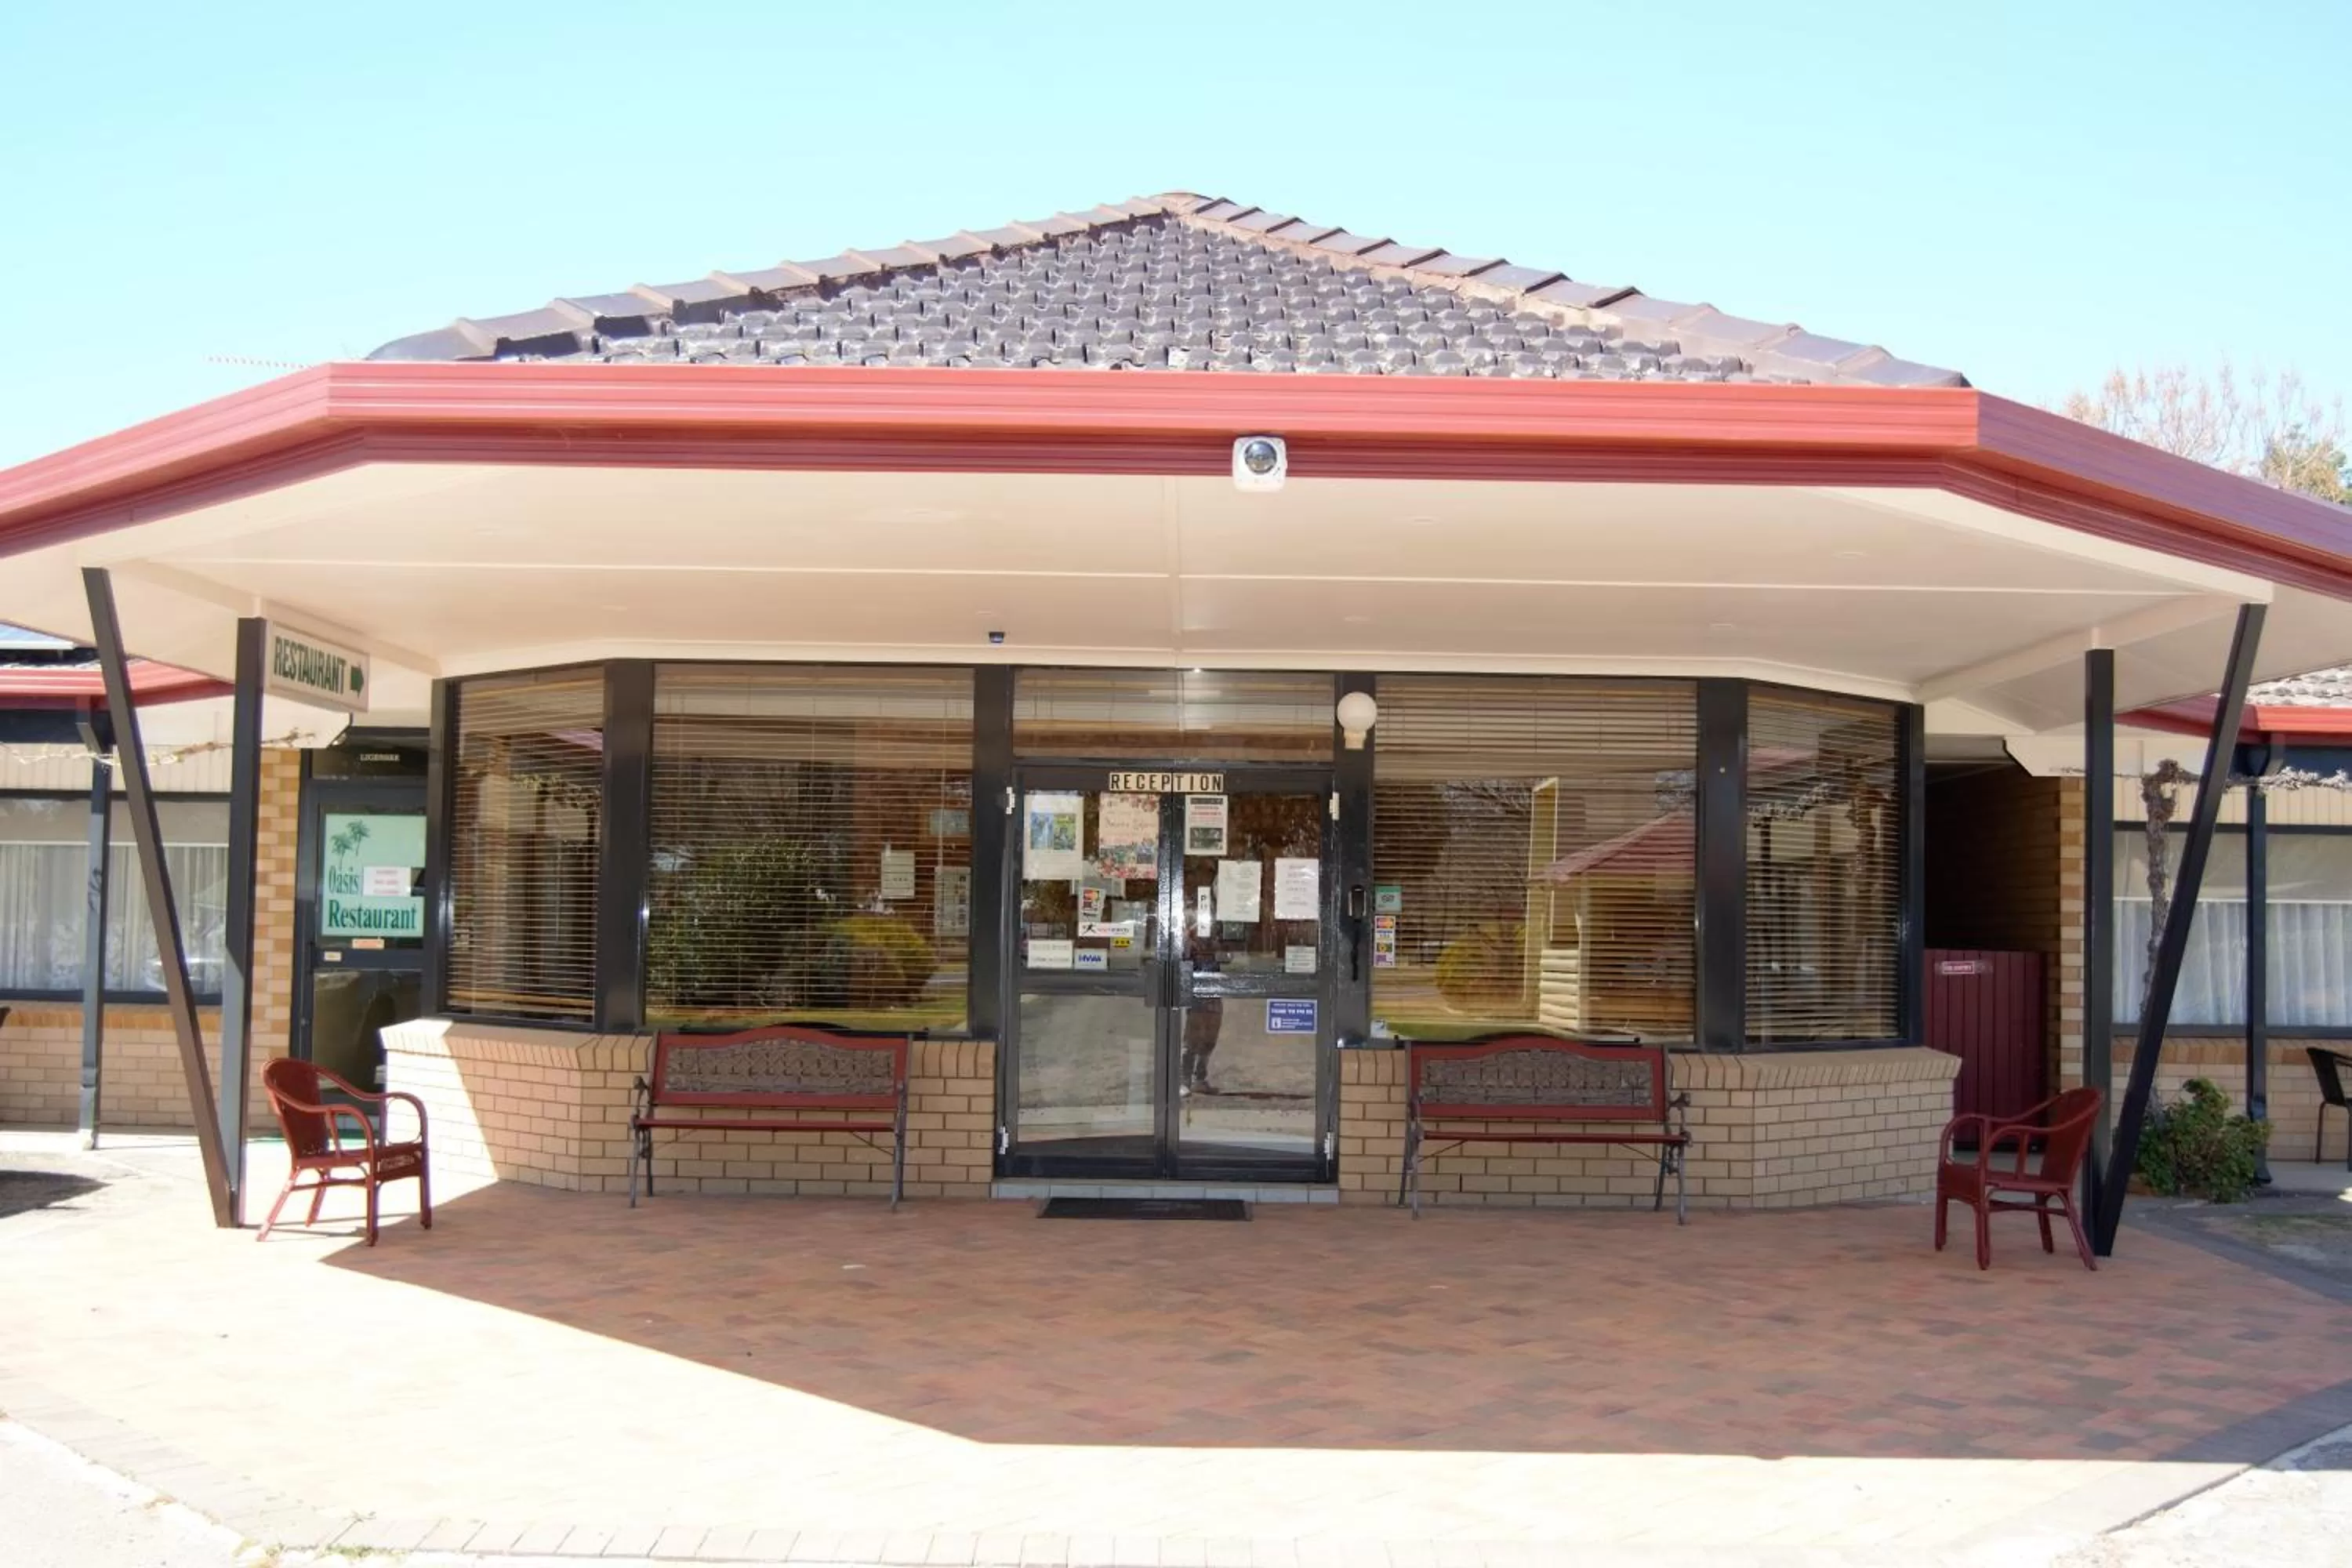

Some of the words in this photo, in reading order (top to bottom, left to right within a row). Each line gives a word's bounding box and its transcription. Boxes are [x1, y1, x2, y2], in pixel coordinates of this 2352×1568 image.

[274, 636, 347, 695] RESTAURANT
[1111, 774, 1221, 791] RECEPTION
[328, 865, 359, 895] Oasis
[328, 899, 417, 929] Restaurant
